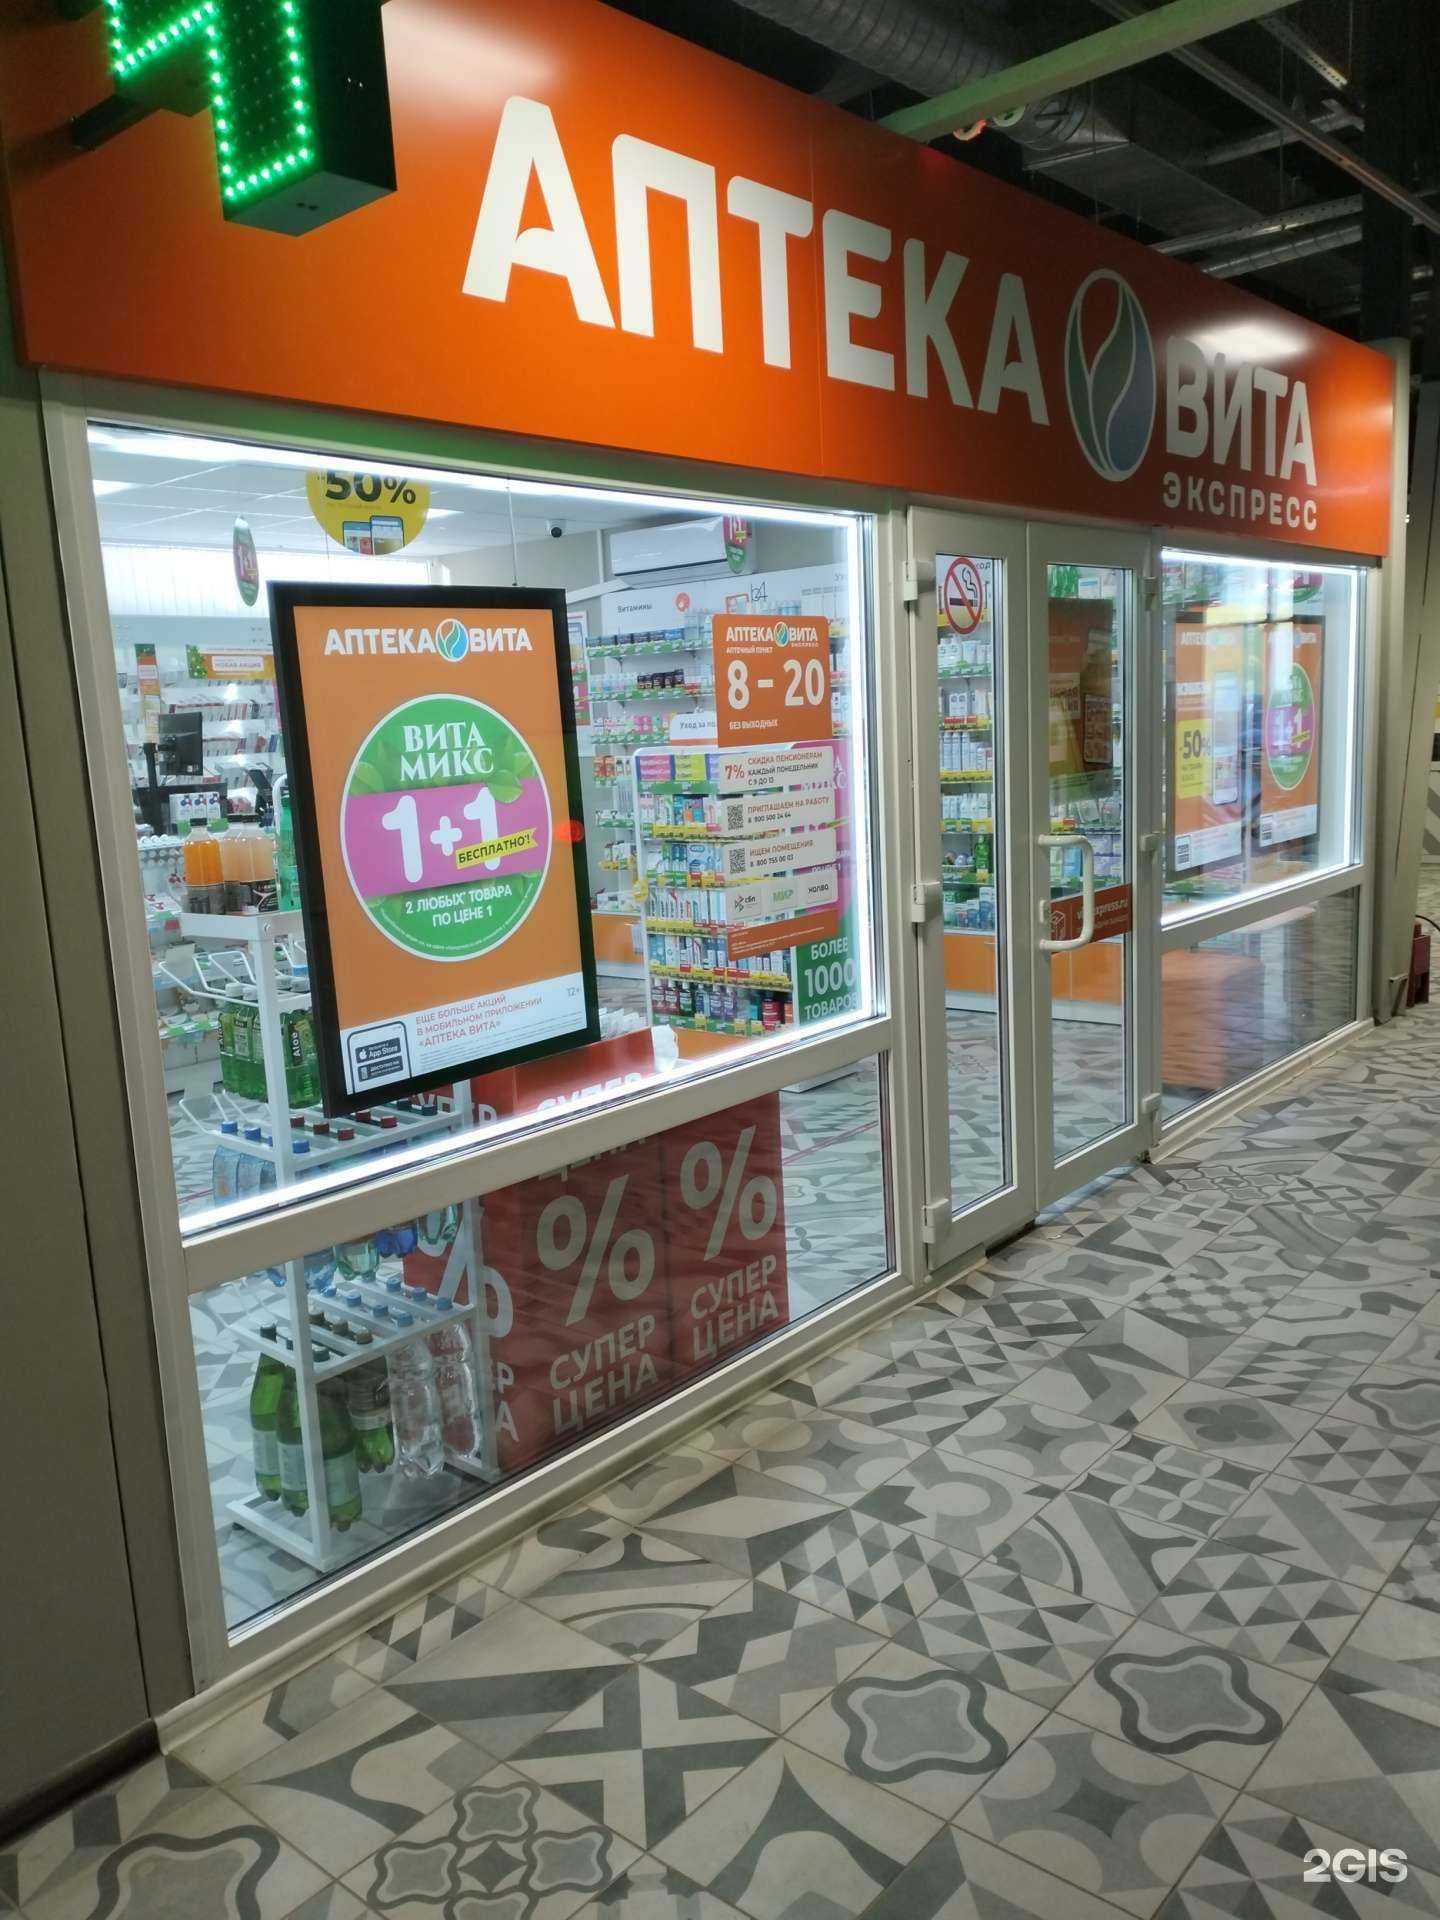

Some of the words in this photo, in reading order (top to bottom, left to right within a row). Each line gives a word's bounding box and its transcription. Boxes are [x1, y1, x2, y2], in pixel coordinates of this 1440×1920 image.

[461, 96, 1049, 425] АПТЕКА
[1164, 334, 1317, 487] ВИТА
[1162, 471, 1319, 532] ЭКСПРЕСС
[324, 627, 437, 656] АПТЕКА
[466, 627, 533, 652] ВИТА
[726, 626, 774, 641] АПТЕКА
[788, 627, 818, 641] ВИТА
[727, 659, 750, 710] 8
[783, 658, 825, 706] 20
[404, 720, 486, 753] ВИТА
[400, 747, 495, 782] МИКС
[725, 764, 745, 780] 7%
[748, 756, 775, 765] СКИДКА
[776, 752, 823, 763] ПЕНСИОНЕРАМ
[748, 766, 775, 776] КАЖДЫЙ
[748, 802, 794, 814] ПРИГЛАШАЕМ
[805, 796, 829, 807] РАБОТУ
[405, 900, 414, 914] 2
[468, 884, 512, 902] ТОВАРА
[432, 913, 451, 927] ПО
[454, 906, 484, 924] ЦЕНЕ
[486, 905, 493, 917] 1
[811, 936, 849, 960] БОЛЕЕ
[804, 957, 856, 997] 1000
[416, 1012, 436, 1025] ЕЩЕ
[438, 1002, 475, 1019] БОЛЬШЕ
[476, 995, 506, 1009] АКЦИЙ
[425, 1013, 483, 1034] МОБИЛЬНОМ
[484, 998, 543, 1019] ПРИЛОЖЕНИИ
[804, 991, 859, 1020] ТОВАРОВ
[292, 1032, 301, 1057] Aloe
[690, 1254, 777, 1320] СУПЕР
[691, 1290, 779, 1362] ЦЕНА
[549, 1314, 656, 1390] СУПЕР
[552, 1352, 659, 1435] ЦЕНА
